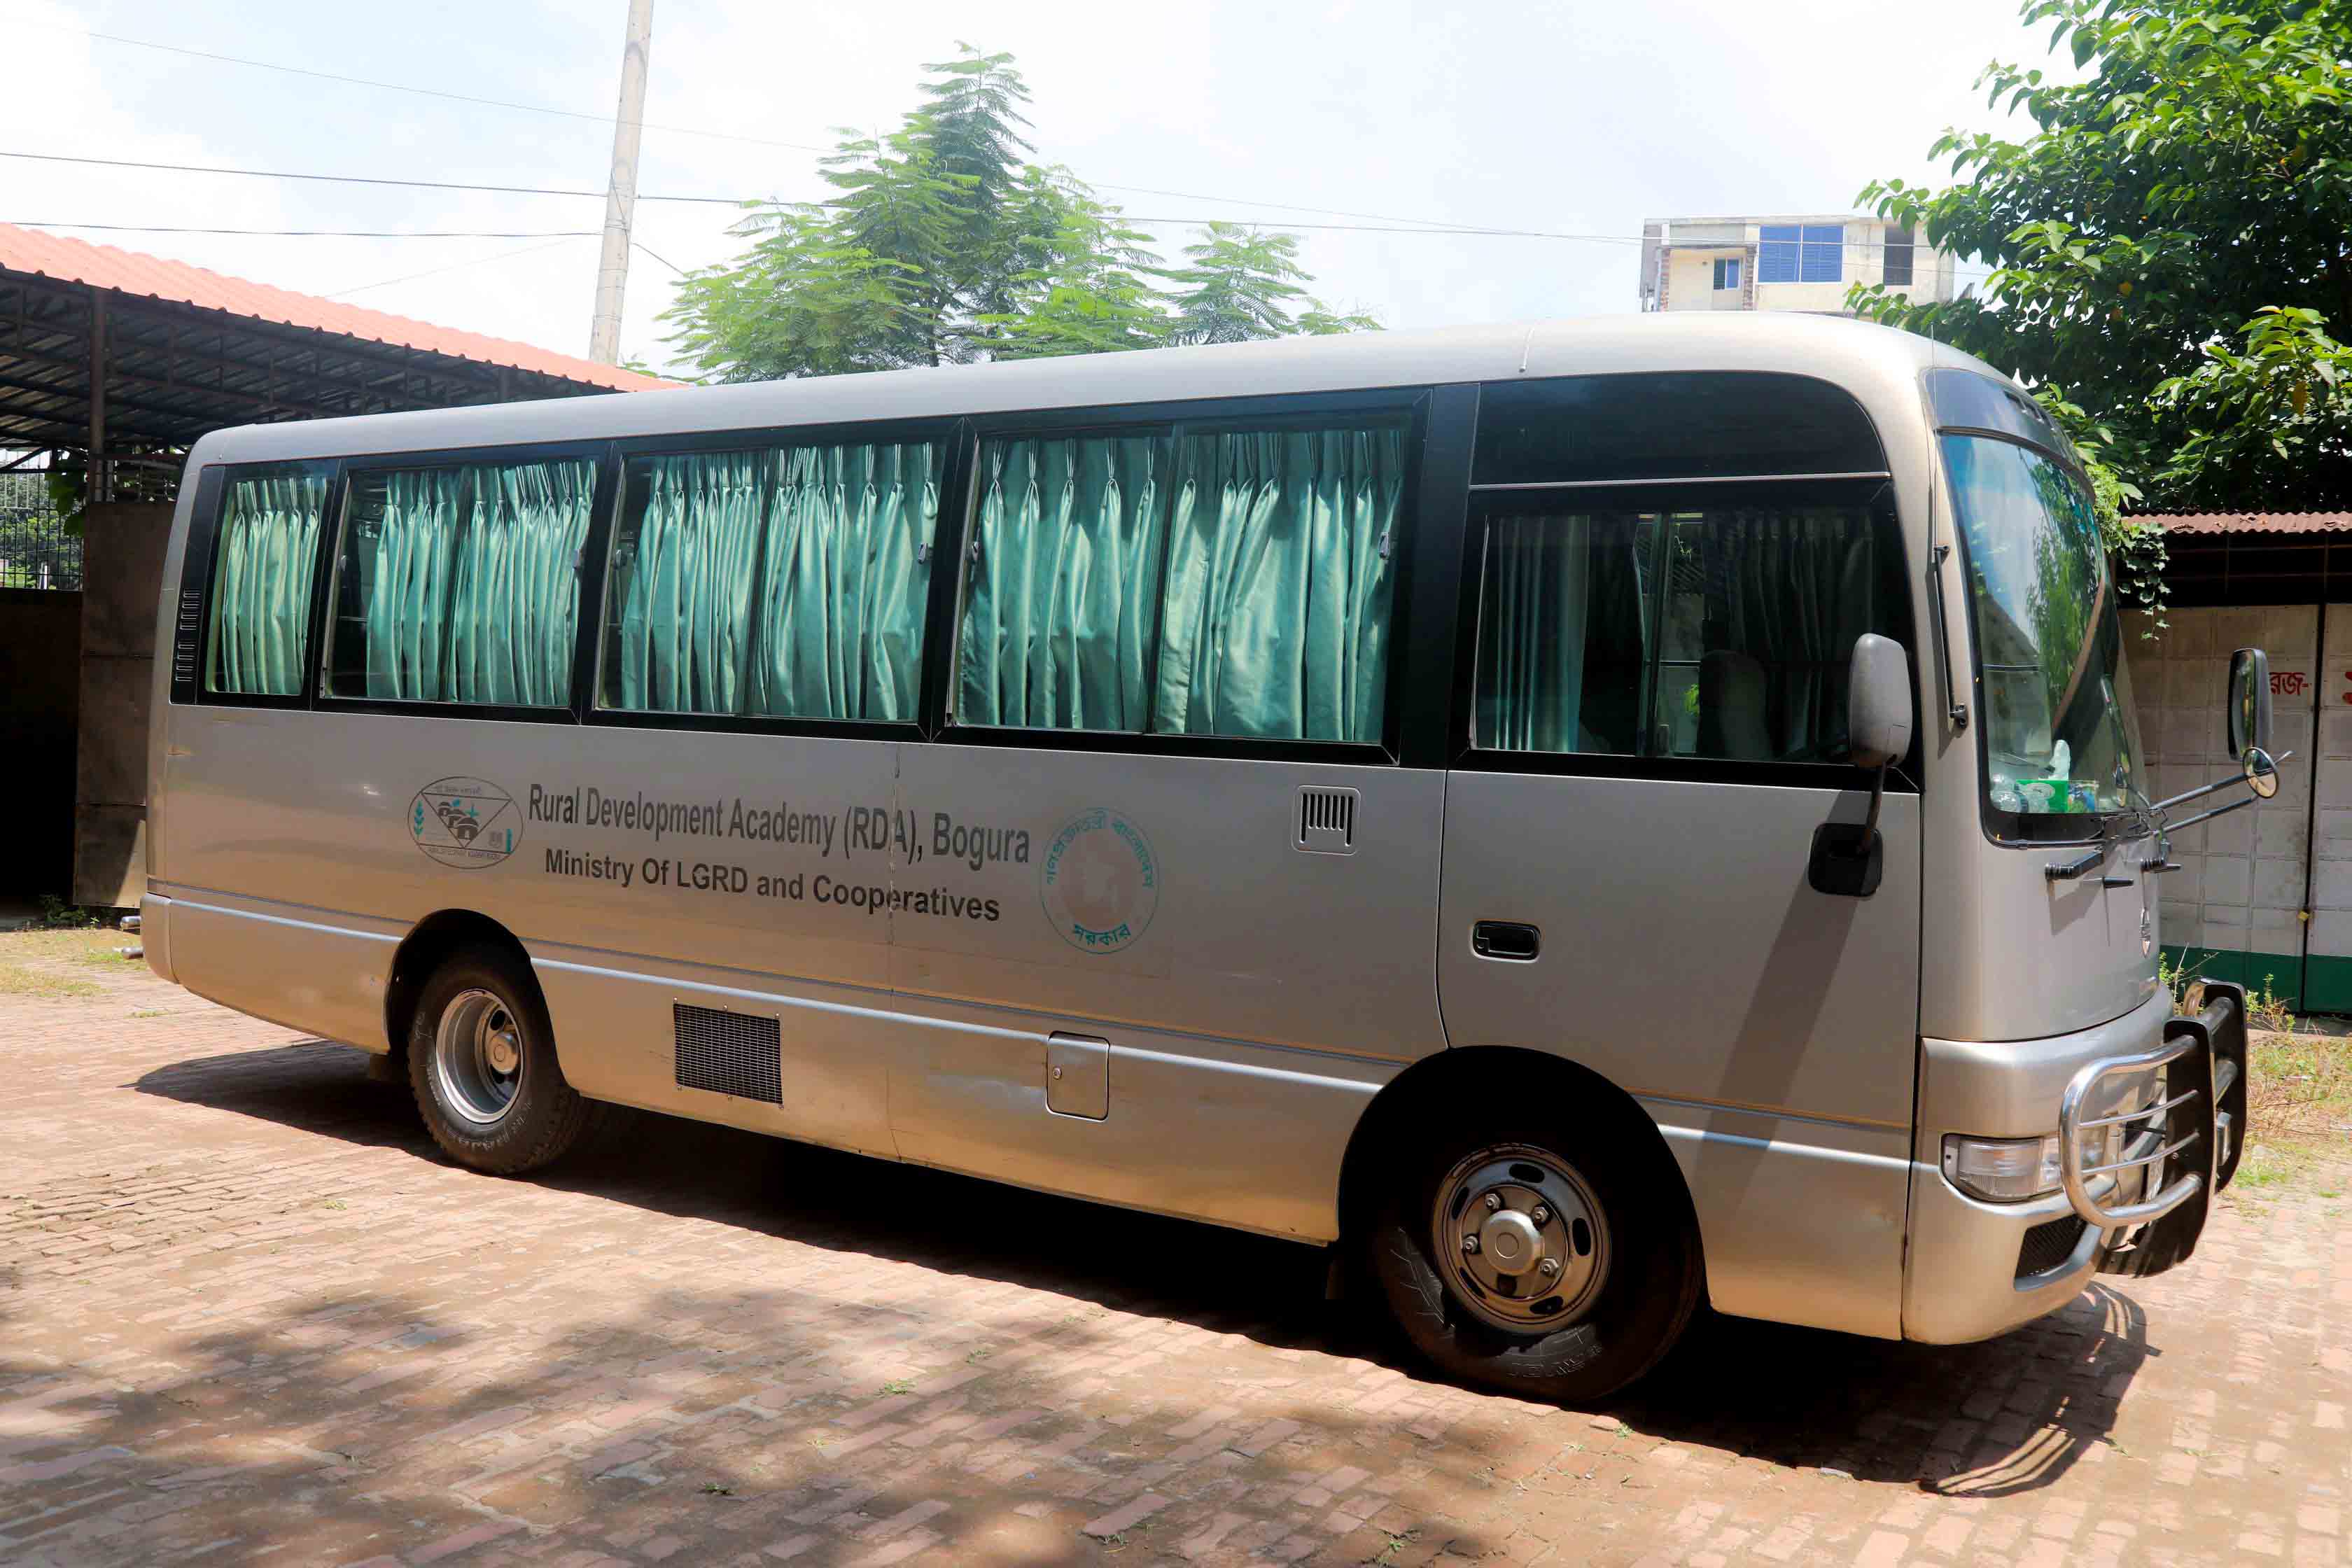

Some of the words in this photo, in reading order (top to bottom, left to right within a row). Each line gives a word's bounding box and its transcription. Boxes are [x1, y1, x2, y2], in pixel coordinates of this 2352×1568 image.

[528, 783, 580, 825] Rural
[585, 788, 723, 842] Development
[728, 798, 837, 858] Academy
[844, 806, 923, 865] (RDA),
[932, 812, 1030, 872] Bogura
[545, 847, 635, 888] Ministry
[641, 858, 671, 886] Of
[677, 860, 748, 894] LGRD
[756, 873, 804, 901] and
[813, 874, 1000, 922] Cooperatives
